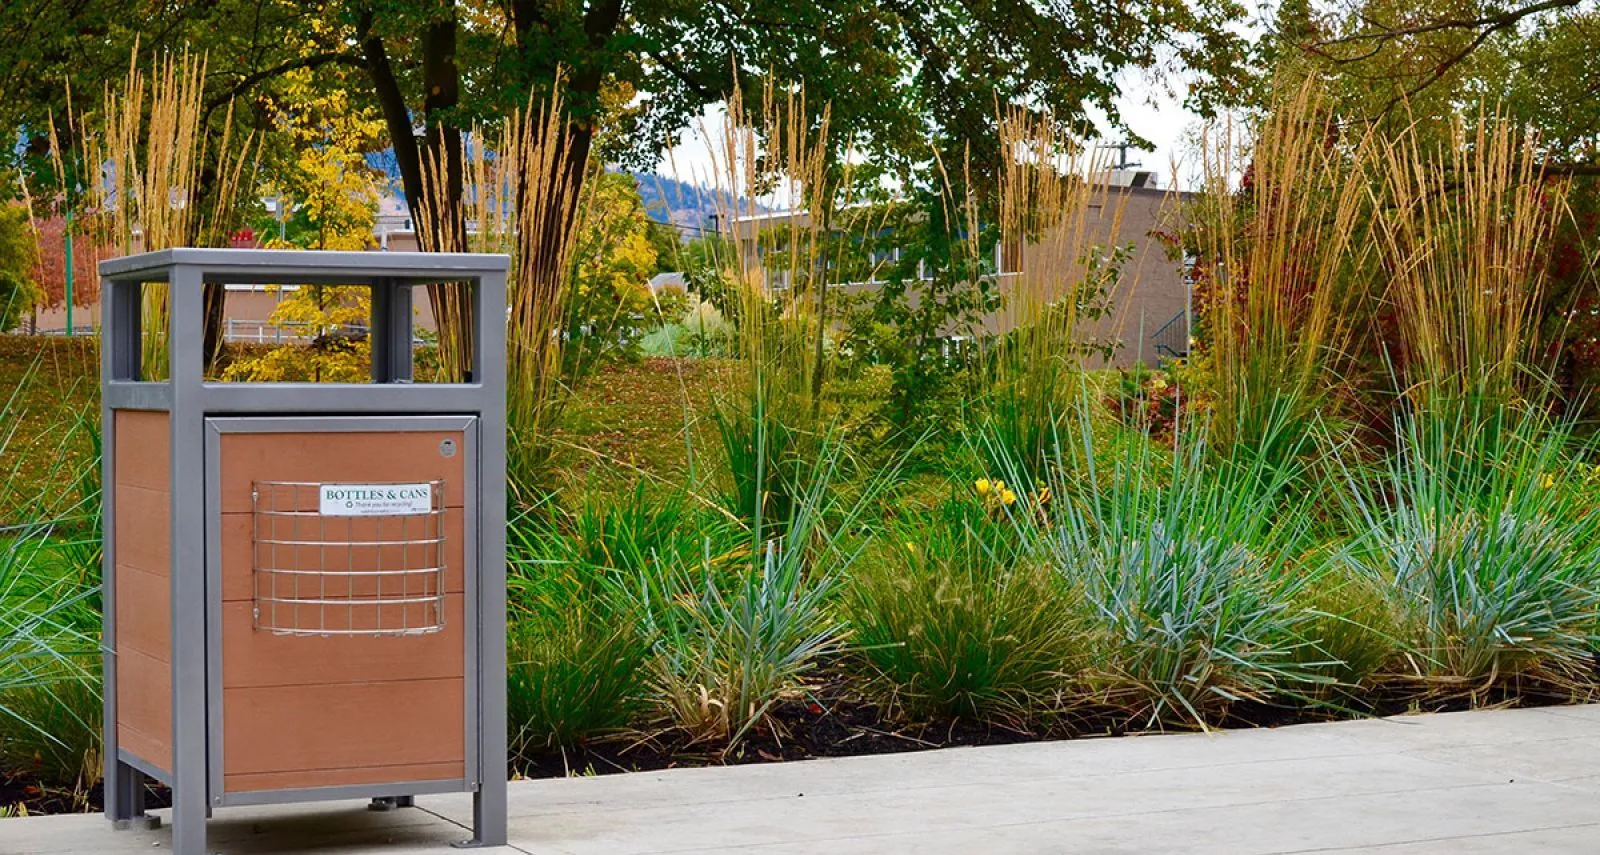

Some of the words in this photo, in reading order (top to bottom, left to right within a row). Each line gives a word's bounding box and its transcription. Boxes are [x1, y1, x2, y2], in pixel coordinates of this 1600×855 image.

[326, 490, 384, 500] BOTTLES
[386, 489, 397, 500] &
[399, 488, 428, 499] CANS
